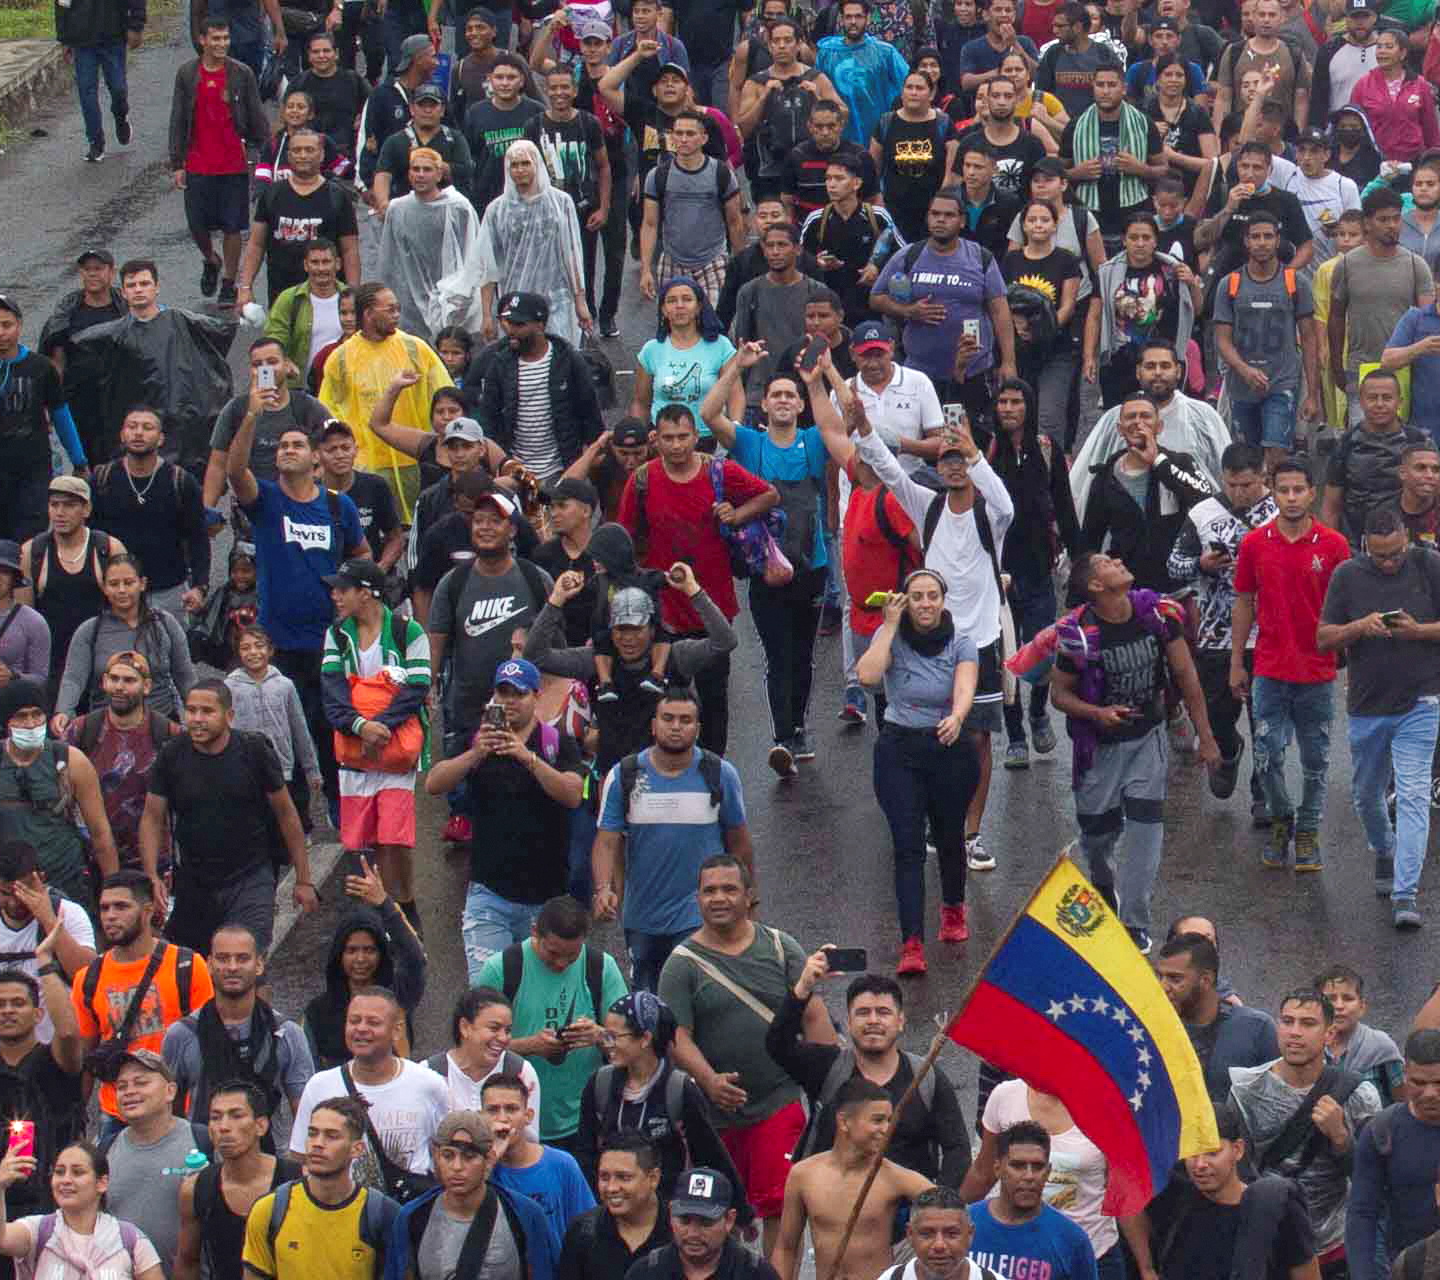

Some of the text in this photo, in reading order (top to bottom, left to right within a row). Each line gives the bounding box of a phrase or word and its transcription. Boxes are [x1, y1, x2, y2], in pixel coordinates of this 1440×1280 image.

[912, 272, 973, 288] I WANT TO...
[471, 596, 516, 621] NIKE
